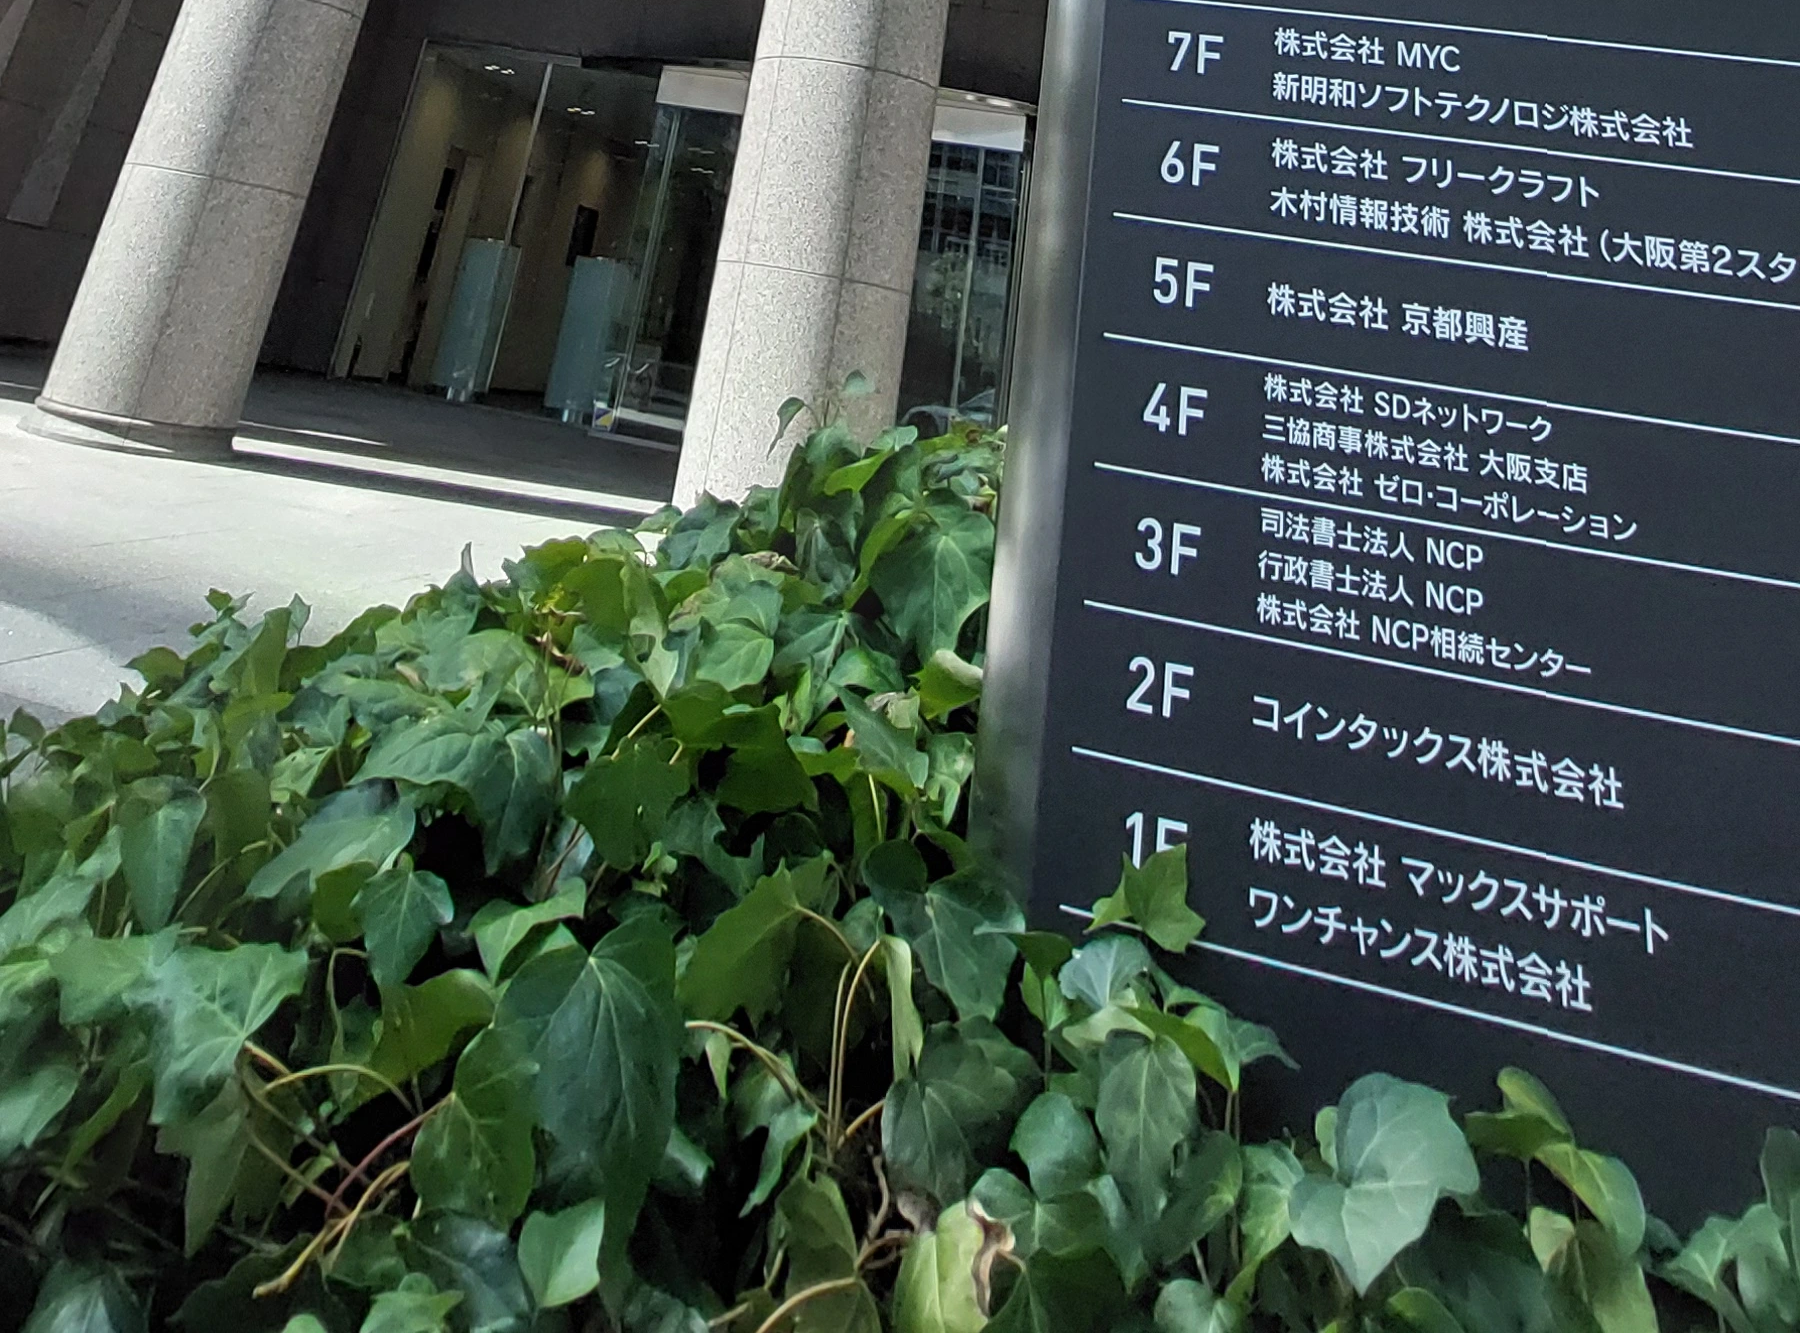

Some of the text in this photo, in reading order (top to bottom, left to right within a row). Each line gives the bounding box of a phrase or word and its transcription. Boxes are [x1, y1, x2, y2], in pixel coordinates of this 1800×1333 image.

[1168, 31, 1224, 74] 7F
[1274, 26, 1461, 72] 株式会社 MYC
[1272, 71, 1694, 148] 新明和ソフトテクノロジ株式会社
[1160, 140, 1220, 186] 6F
[1271, 137, 1600, 208] 株式会社 フリークラフト
[1269, 186, 1451, 239] 木村情報技術
[1463, 210, 1590, 258] 株式会社
[1153, 256, 1214, 308] 5F
[1266, 282, 1529, 351] 株式会社 京都興産
[1143, 382, 1208, 436] 4F
[1263, 372, 1552, 442] 株式会社 SDネットワーク
[1261, 452, 1364, 497] 株式会社
[1262, 414, 1588, 494] 三協商事株式会社 大阪支店
[1135, 517, 1202, 575] 3F
[1260, 507, 1484, 571] 司法書士法人 NCP
[1258, 549, 1484, 615] 行政書士法人 NCP
[1256, 592, 1592, 677] 株式会社 NCP相続センター
[1126, 656, 1194, 718] 2F
[1252, 695, 1624, 809] コインタックス株式会社
[1249, 817, 1669, 954] 株式会社 マックスサポート
[1249, 887, 1593, 1012] ワンチャンス株式会社
